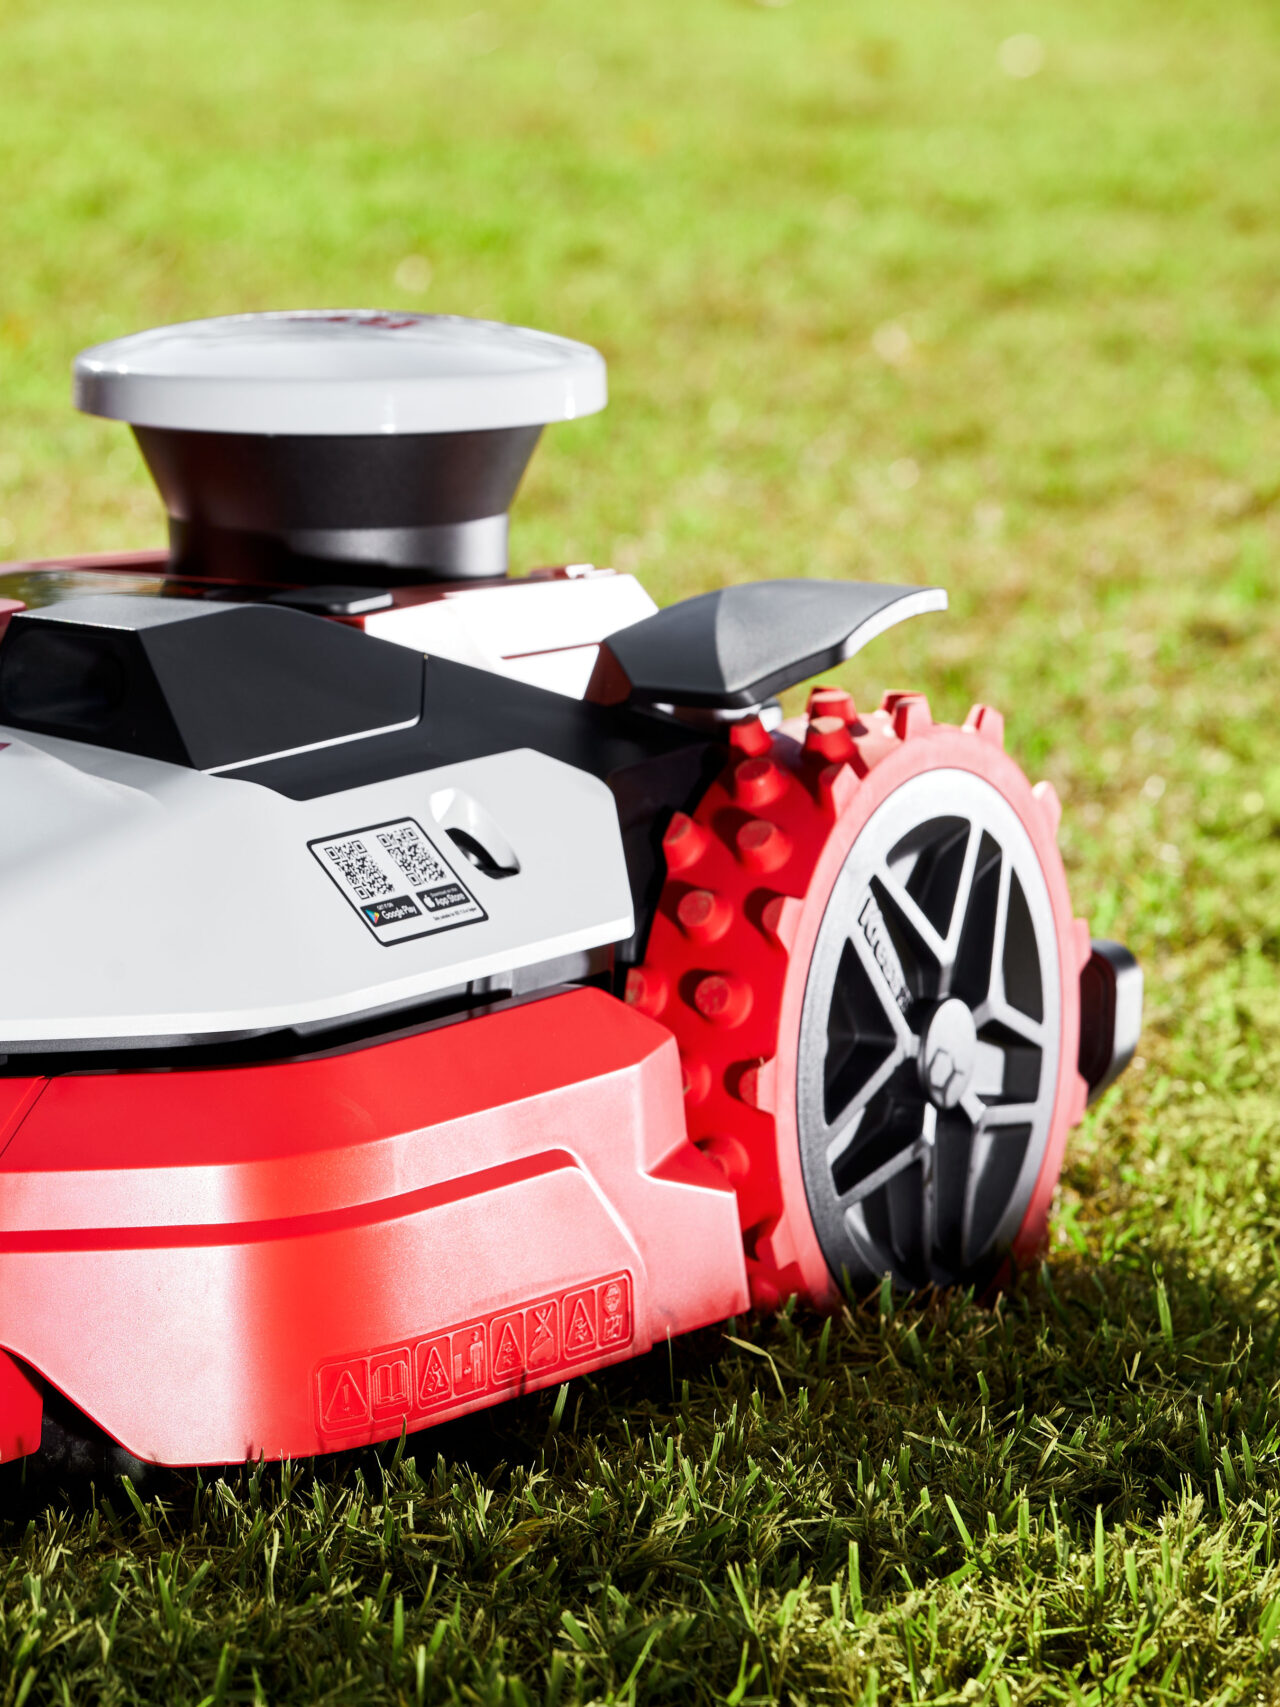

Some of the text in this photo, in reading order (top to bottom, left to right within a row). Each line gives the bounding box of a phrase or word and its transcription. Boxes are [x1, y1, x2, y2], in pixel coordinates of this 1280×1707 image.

[434, 897, 450, 906] App
[381, 904, 418, 920] Google Play
